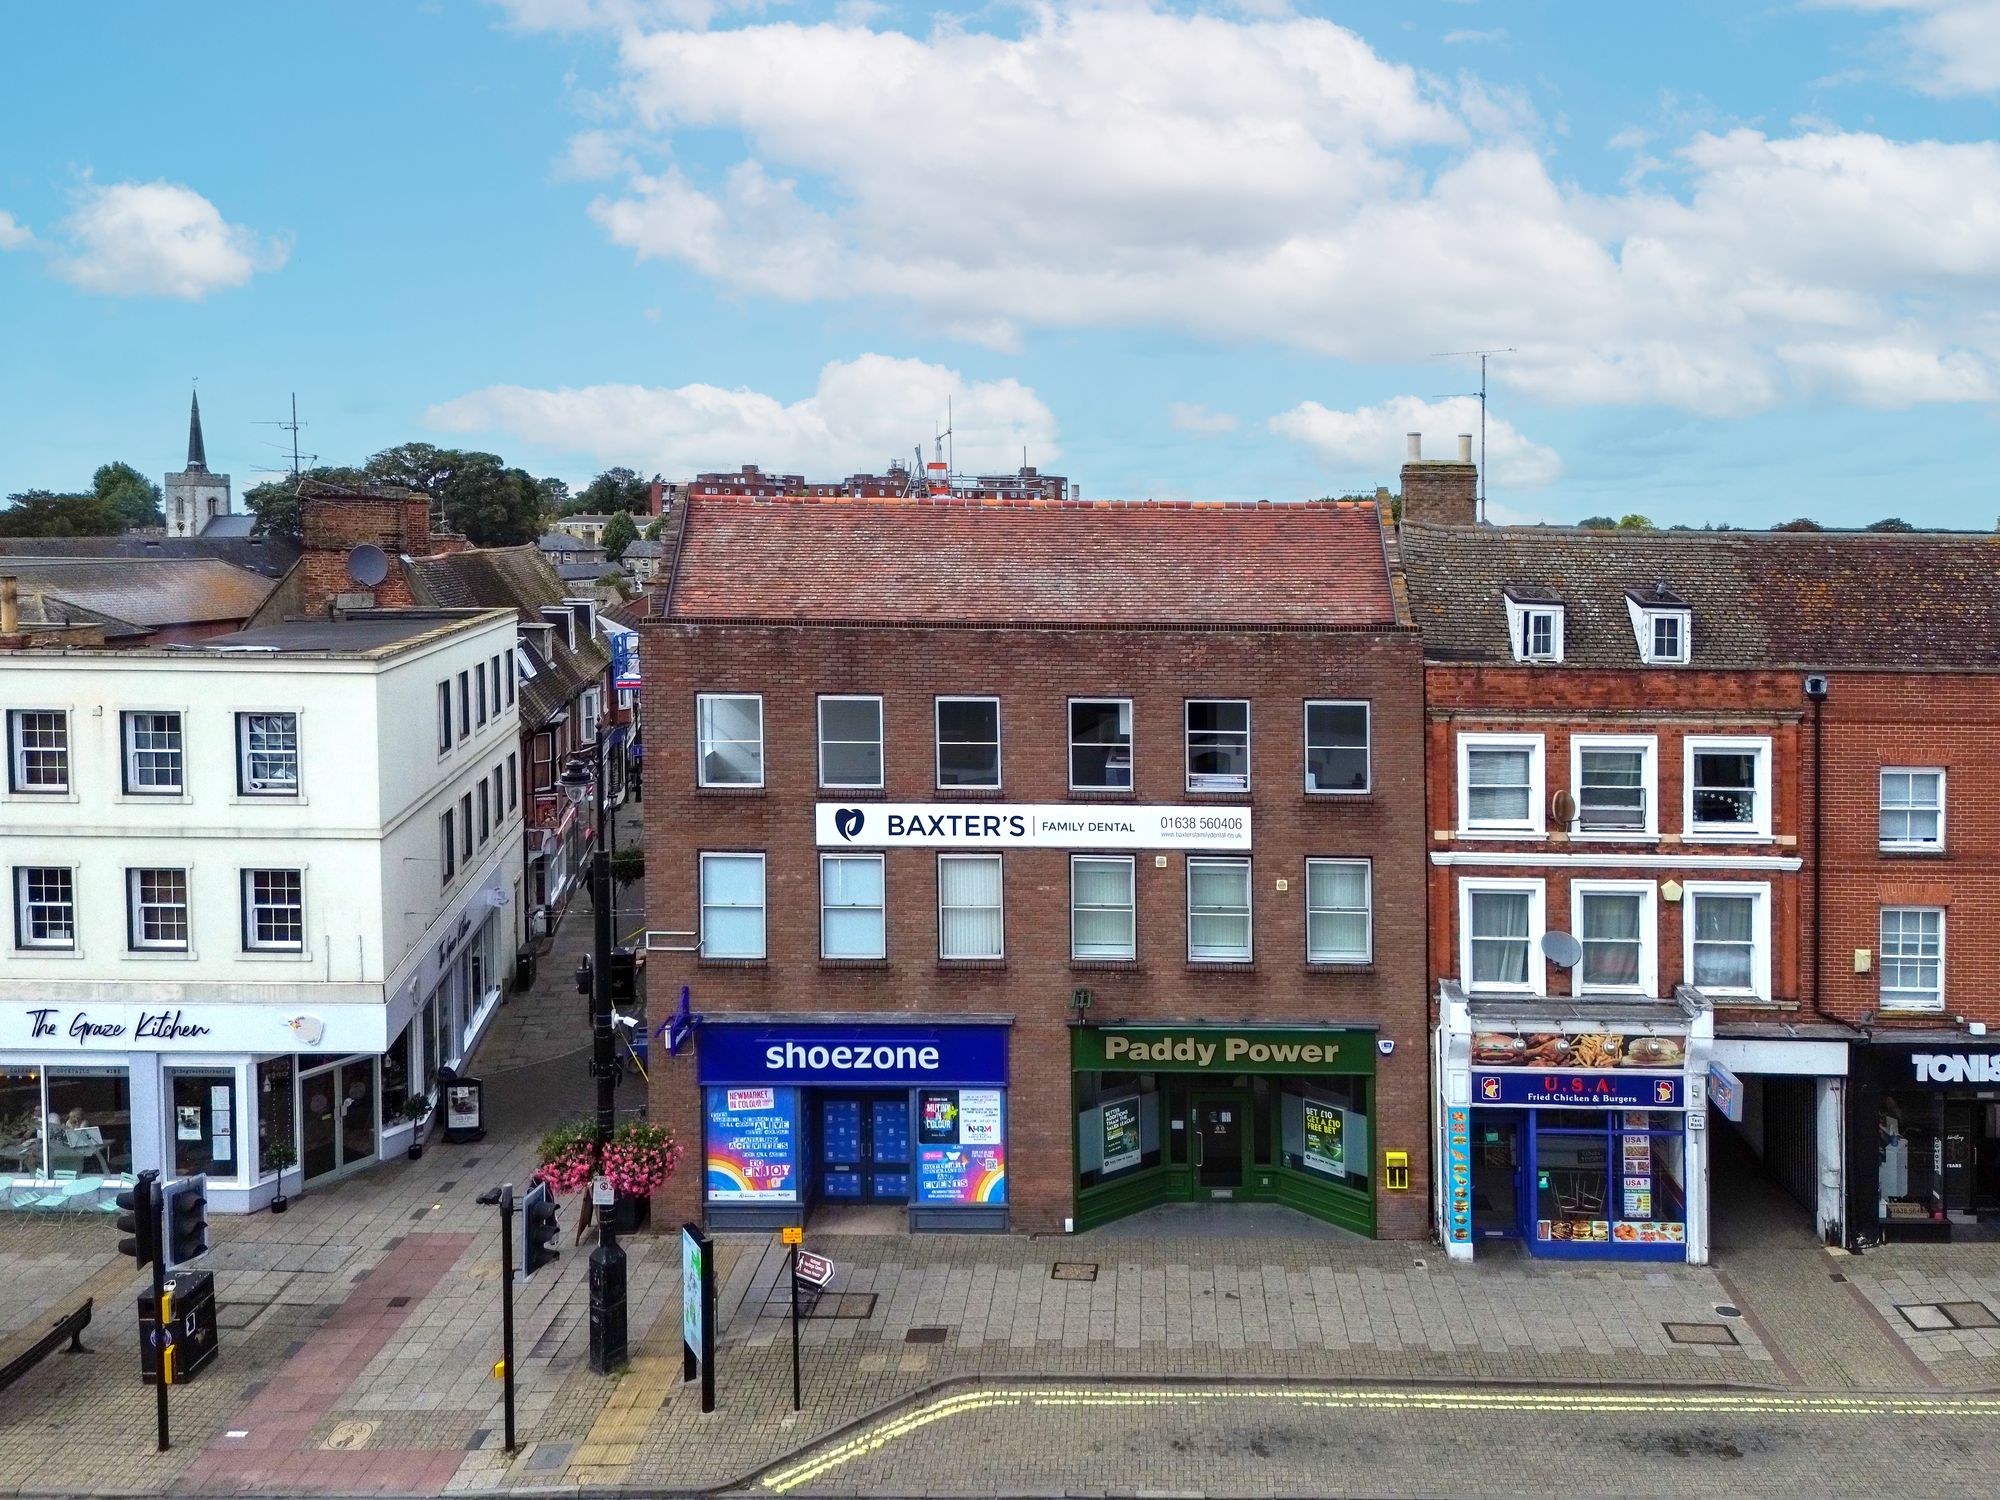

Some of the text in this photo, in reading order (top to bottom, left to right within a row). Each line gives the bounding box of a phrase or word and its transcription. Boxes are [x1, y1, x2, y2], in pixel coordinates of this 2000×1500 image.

[888, 814, 1025, 837] BAXTER'S
[1042, 821, 1136, 833] FAMILY DENTAL
[1160, 816, 1243, 830] 01638 560406
[26, 1008, 210, 1045] The Graze Kitchen
[765, 1042, 940, 1070] shoezone
[1105, 1036, 1340, 1067] Paddy Power
[729, 1090, 768, 1100] NEWMARKET
[1527, 1093, 1637, 1103] Fried Chicken & Burgers
[729, 1100, 737, 1109] IN
[738, 1100, 762, 1109] COLOUR
[1306, 1107, 1333, 1119] BET £10
[754, 1121, 790, 1130] ALIVE
[926, 1119, 951, 1129] COLOUR
[1306, 1115, 1319, 1124] GET
[1328, 1119, 1341, 1128] £10
[1307, 1122, 1337, 1135] FREE BET
[728, 1142, 789, 1150] ACTIVITIES
[1624, 1136, 1642, 1144] USA
[749, 1159, 765, 1167] TO
[742, 1165, 791, 1178] ENJOY
[923, 1179, 969, 1190] EVENTS
